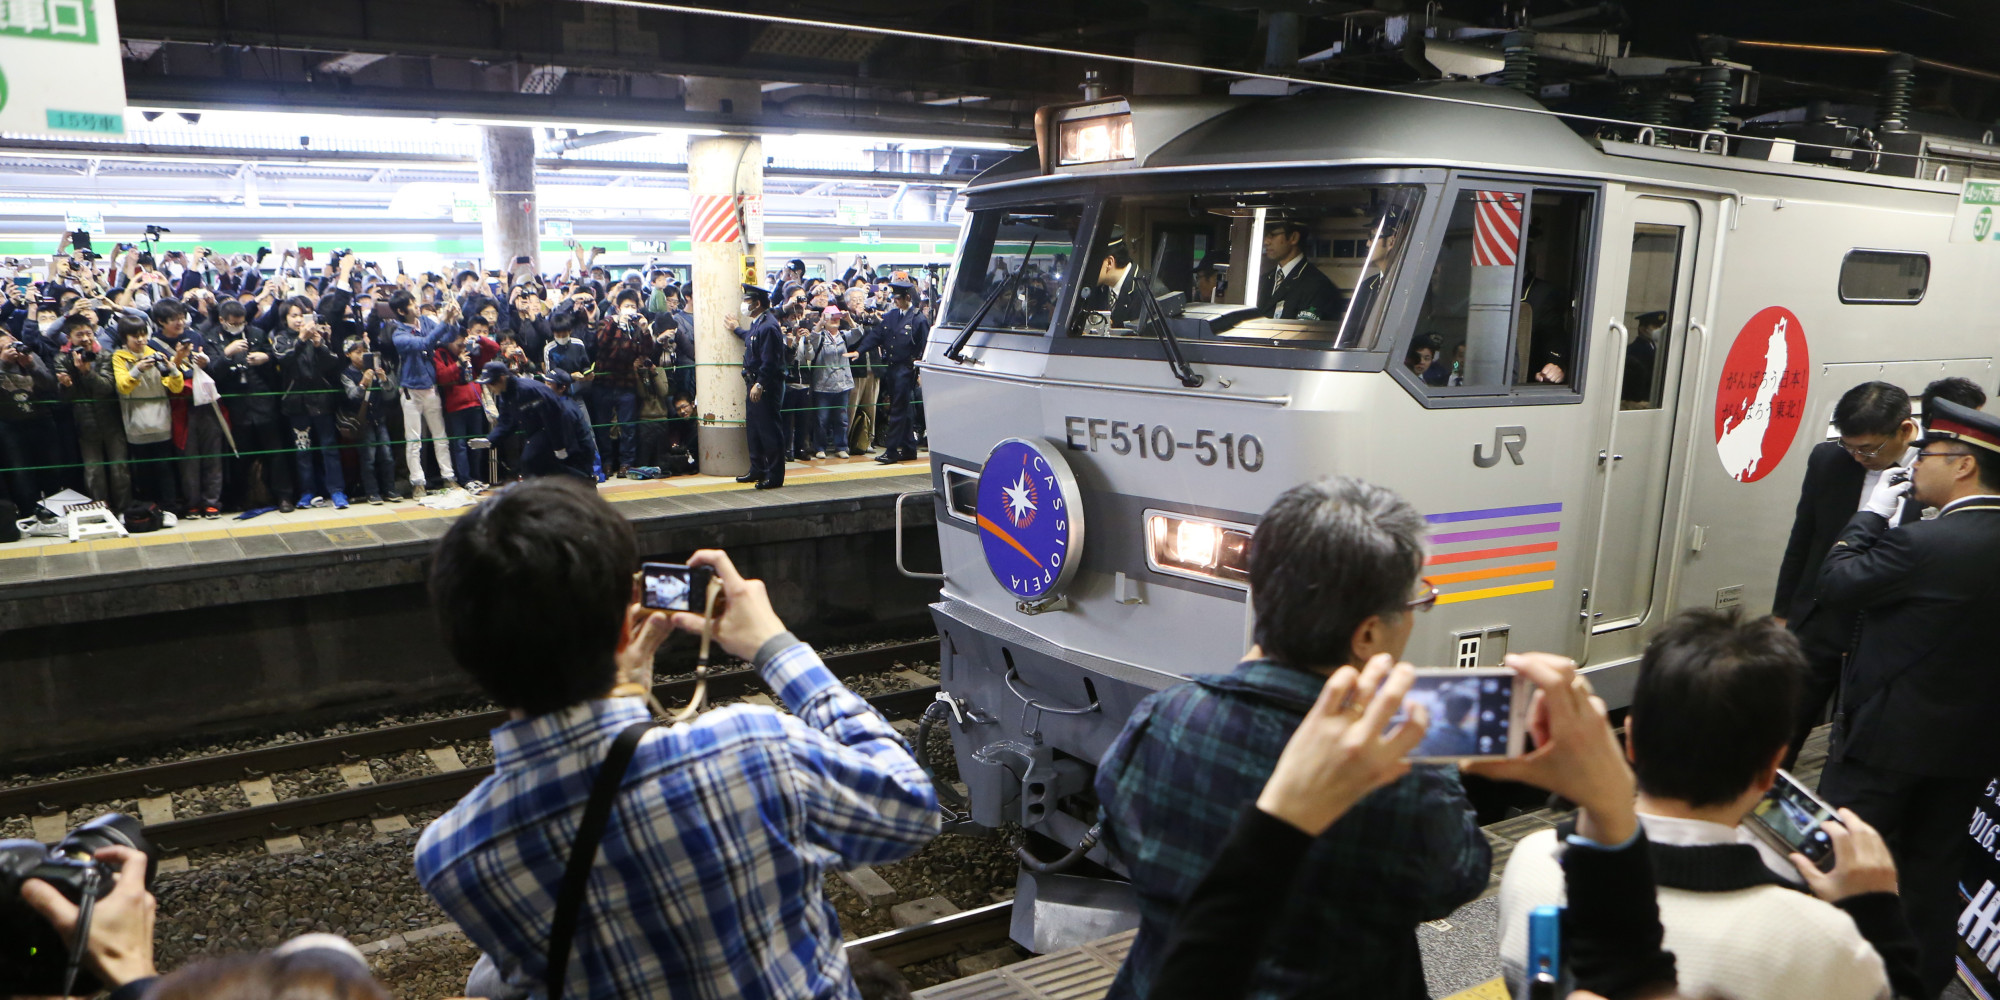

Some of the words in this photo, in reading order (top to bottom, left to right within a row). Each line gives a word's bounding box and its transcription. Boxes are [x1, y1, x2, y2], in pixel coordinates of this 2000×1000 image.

[0, 0, 86, 36] 車口
[1065, 416, 1264, 473] EF510-510
[1473, 425, 1527, 469] JR
[1011, 456, 1066, 592] CASSIOPEIA
